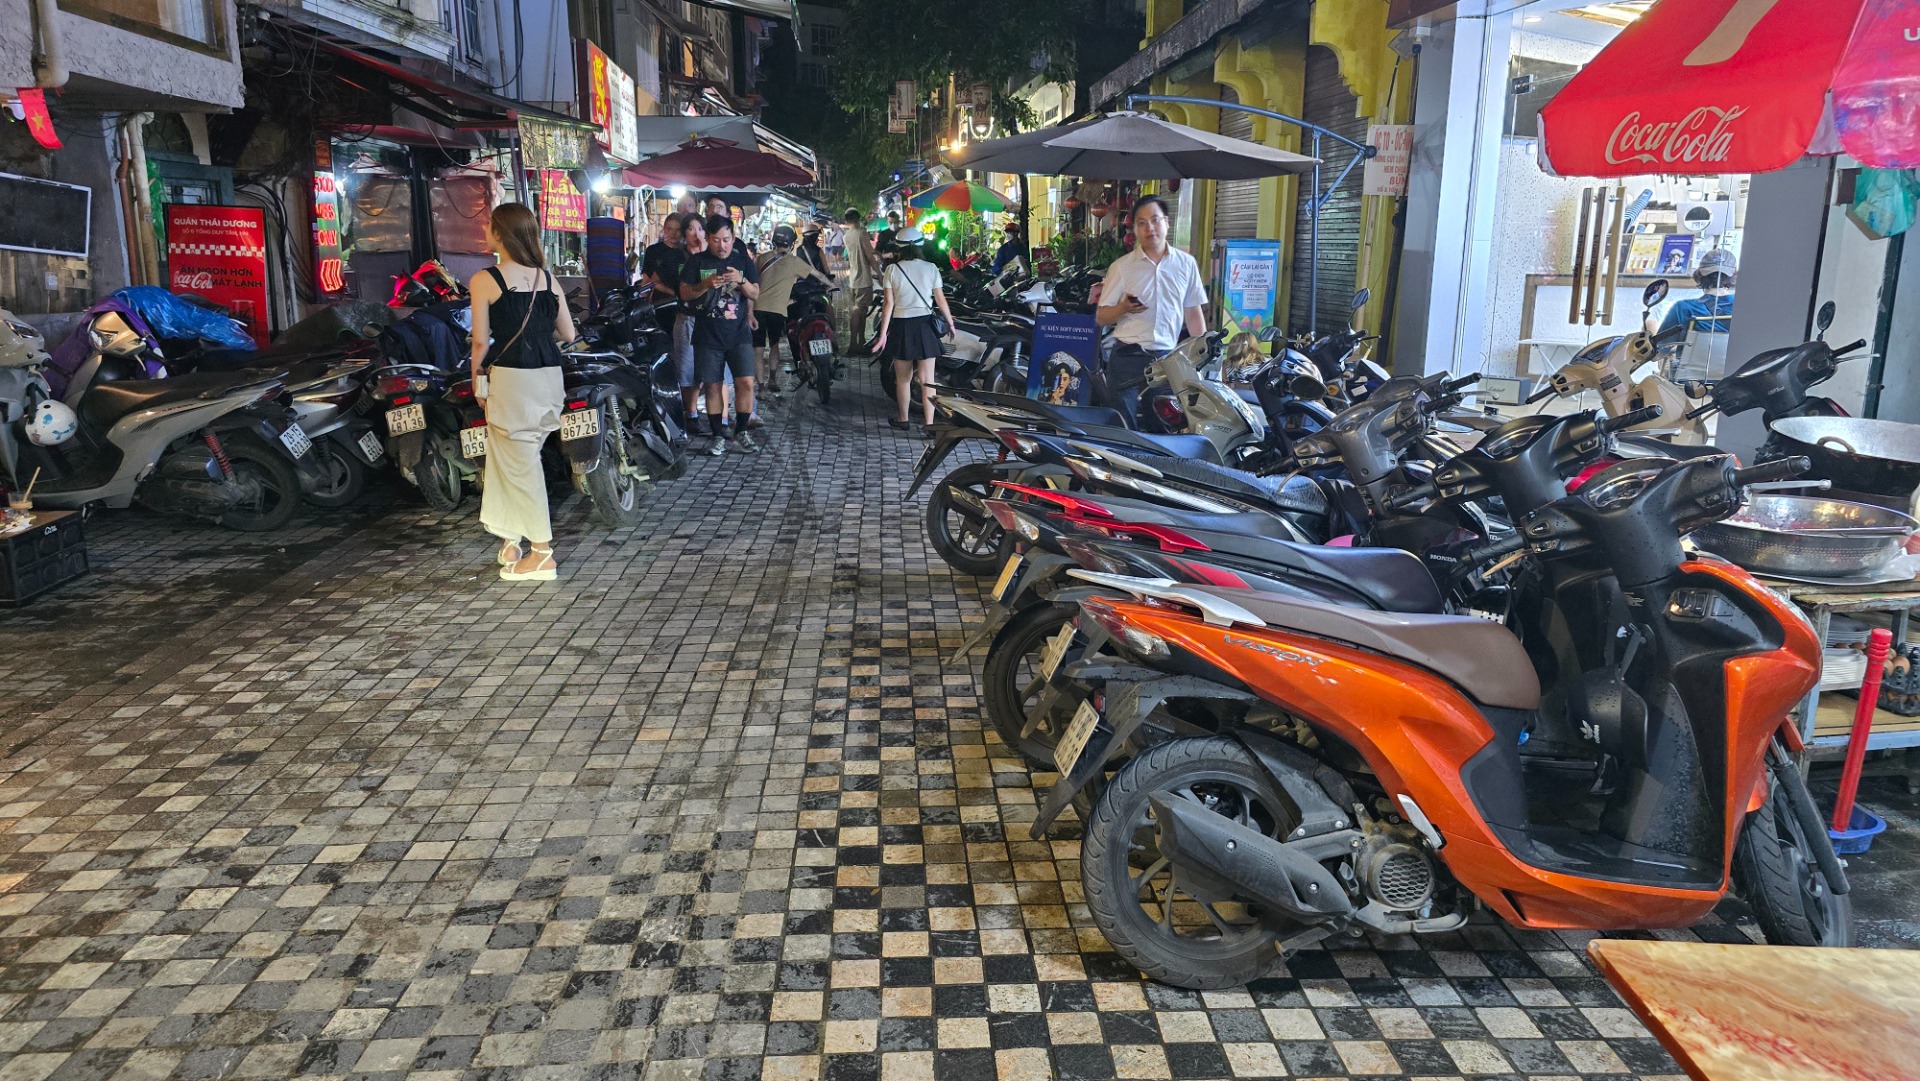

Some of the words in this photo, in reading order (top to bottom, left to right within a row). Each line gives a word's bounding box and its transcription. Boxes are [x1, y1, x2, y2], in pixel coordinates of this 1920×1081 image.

[1605, 105, 1750, 165] Coca-Cola
[174, 217, 198, 226] QUÁN
[199, 218, 221, 227] THÁI
[223, 219, 257, 229] DƯƠNG
[566, 411, 592, 426] 29-L1
[563, 422, 597, 439] 967.26
[1429, 553, 1458, 563] HONDA
[1224, 633, 1324, 667] VISION
